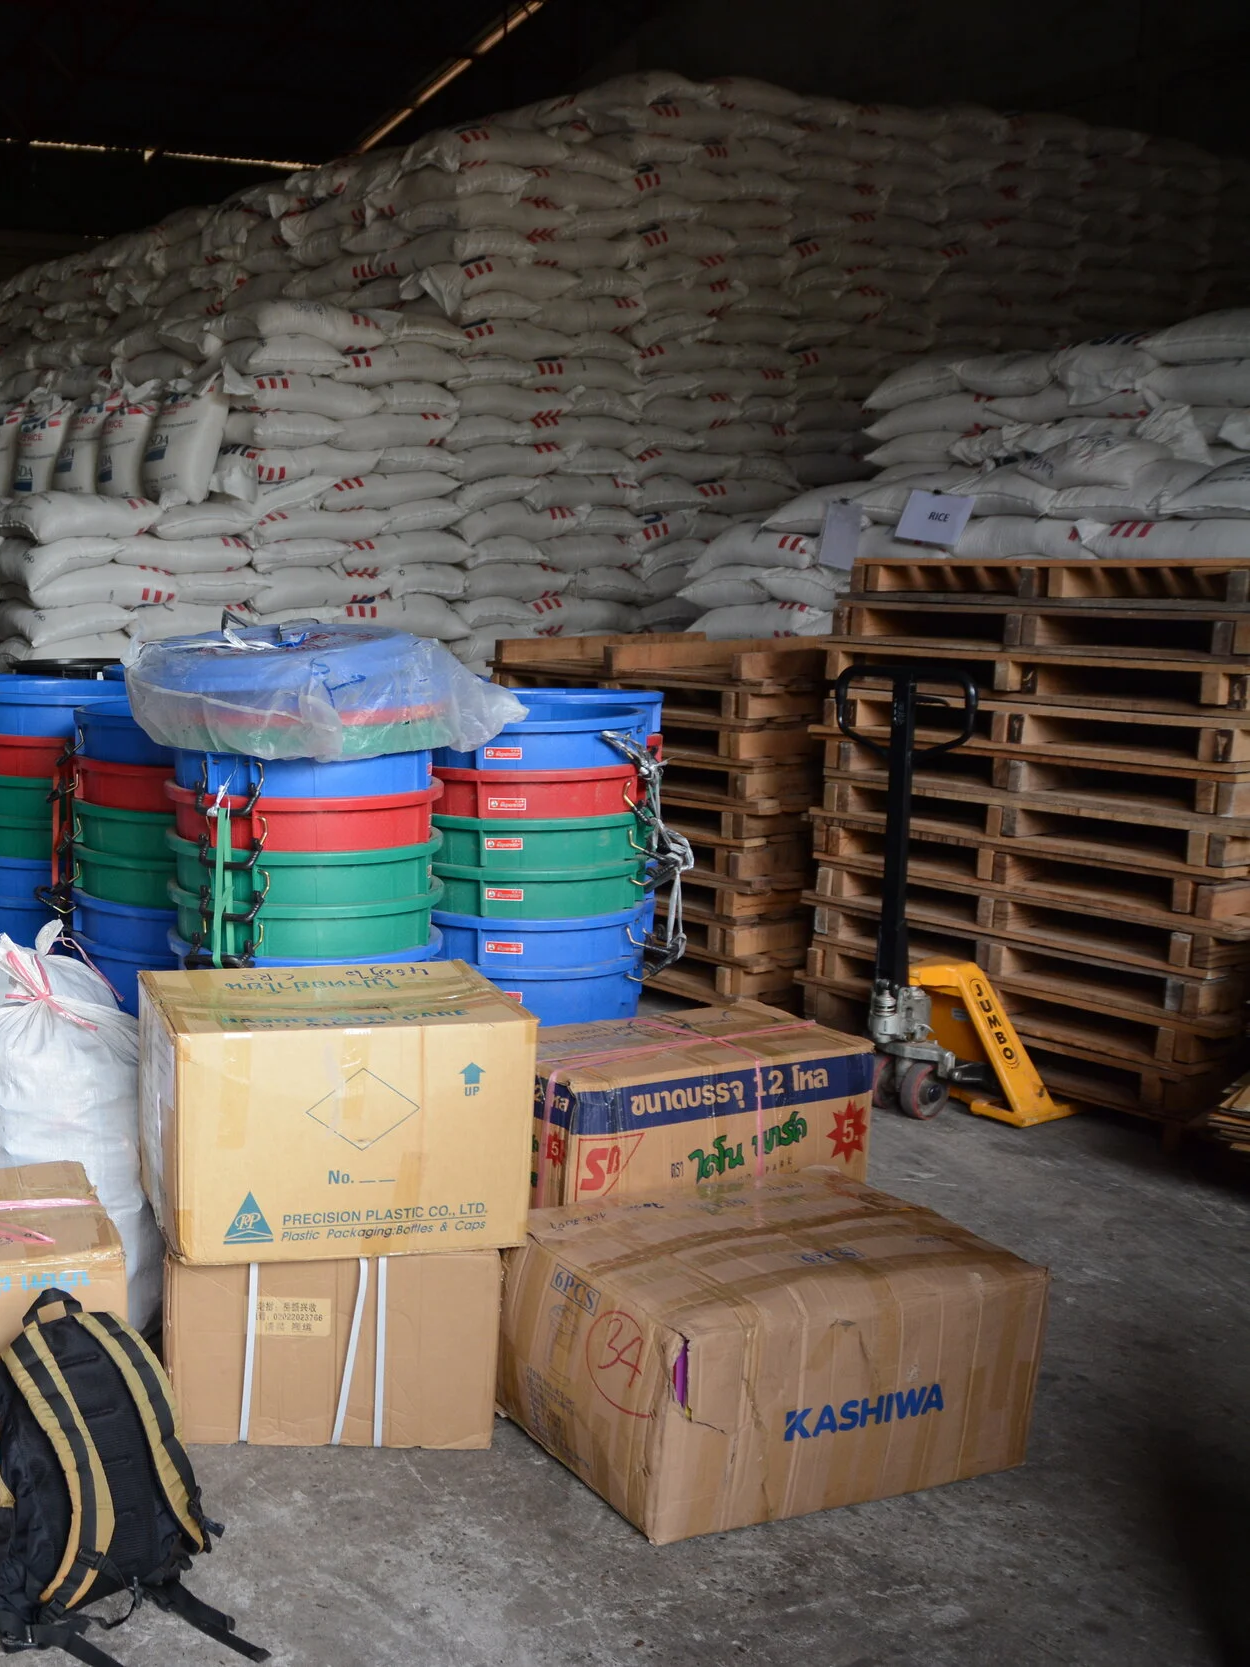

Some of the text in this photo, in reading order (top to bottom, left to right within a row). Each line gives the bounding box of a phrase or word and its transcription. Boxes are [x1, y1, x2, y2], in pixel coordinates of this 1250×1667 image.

[927, 511, 951, 523] RICE
[402, 1008, 470, 1021] CARE
[974, 983, 1015, 1060] JUMBO
[464, 1086, 480, 1097] UP
[631, 1064, 829, 1116] ขนาดบรรจุ 12 โหล
[551, 1141, 559, 1156] 5
[328, 1170, 355, 1185] No.
[283, 1202, 488, 1225] PRECISION PLASTIC CO., LTD.
[281, 1230, 321, 1242] Plastic
[440, 1222, 447, 1232] &
[455, 1219, 486, 1232] Caps
[21, 1271, 91, 1292] บริษัท
[555, 1271, 594, 1312] 6PCS
[783, 1383, 944, 1441] KASHIWA
